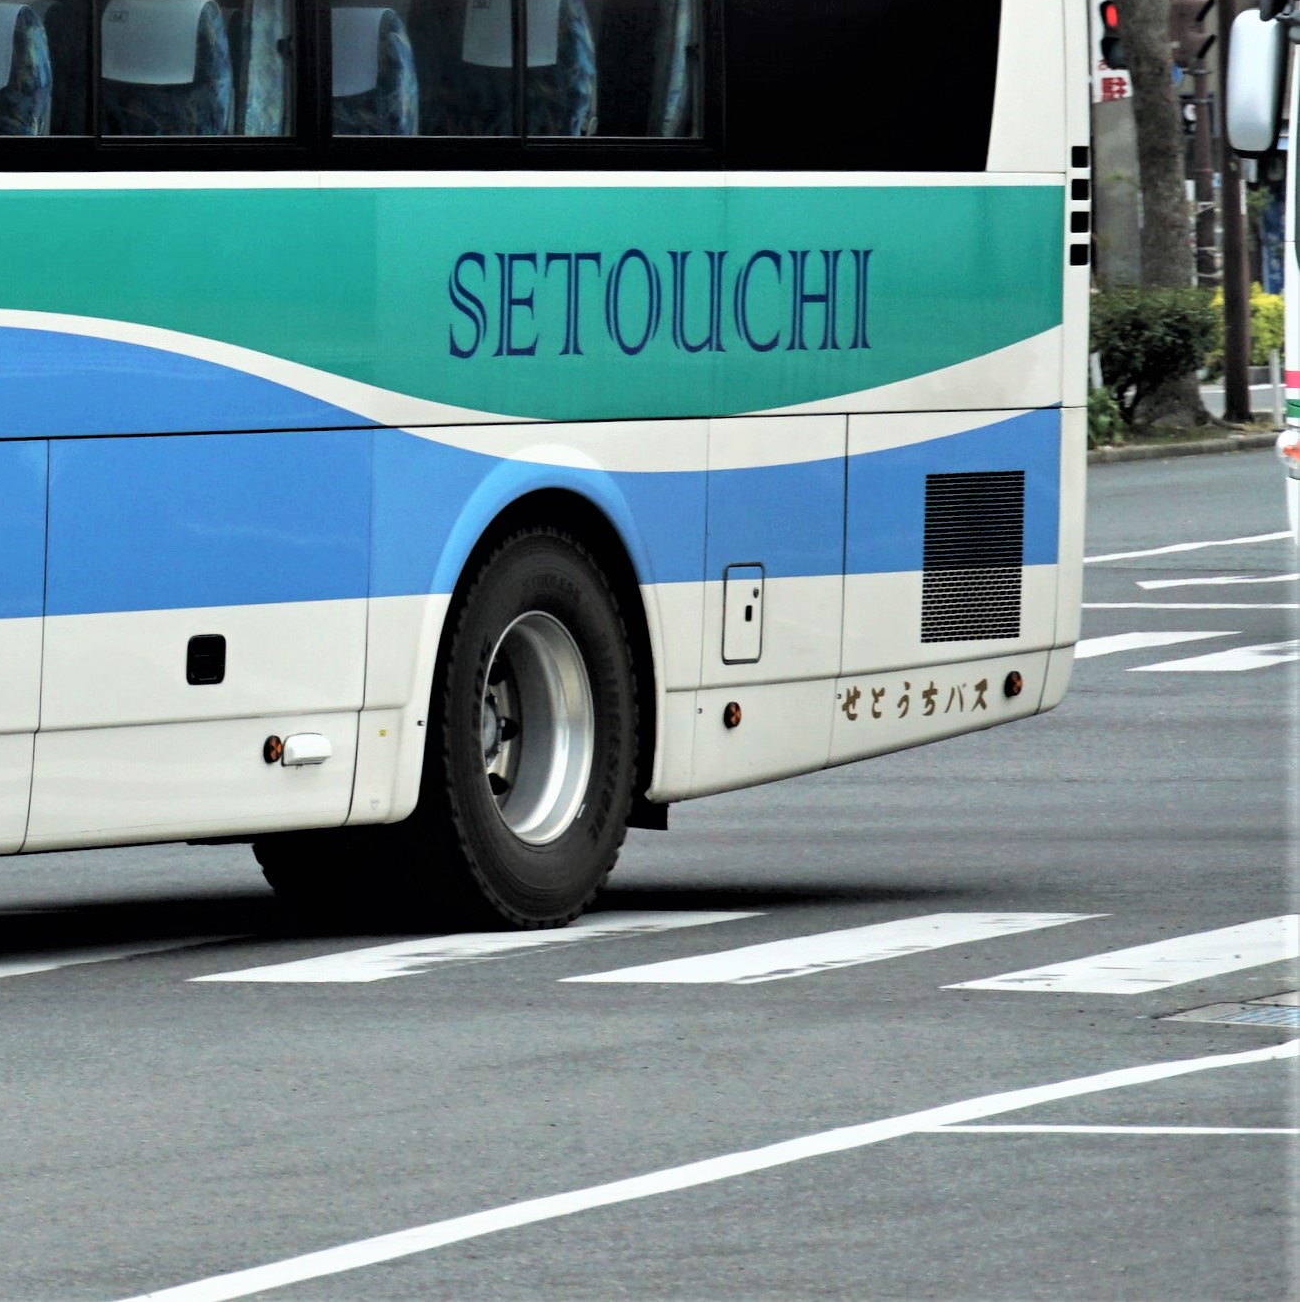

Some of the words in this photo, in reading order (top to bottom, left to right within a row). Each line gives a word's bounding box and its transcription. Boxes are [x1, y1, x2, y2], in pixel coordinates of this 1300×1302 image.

[448, 248, 873, 359] SETOUCHI
[841, 678, 988, 721] せとうちバス
